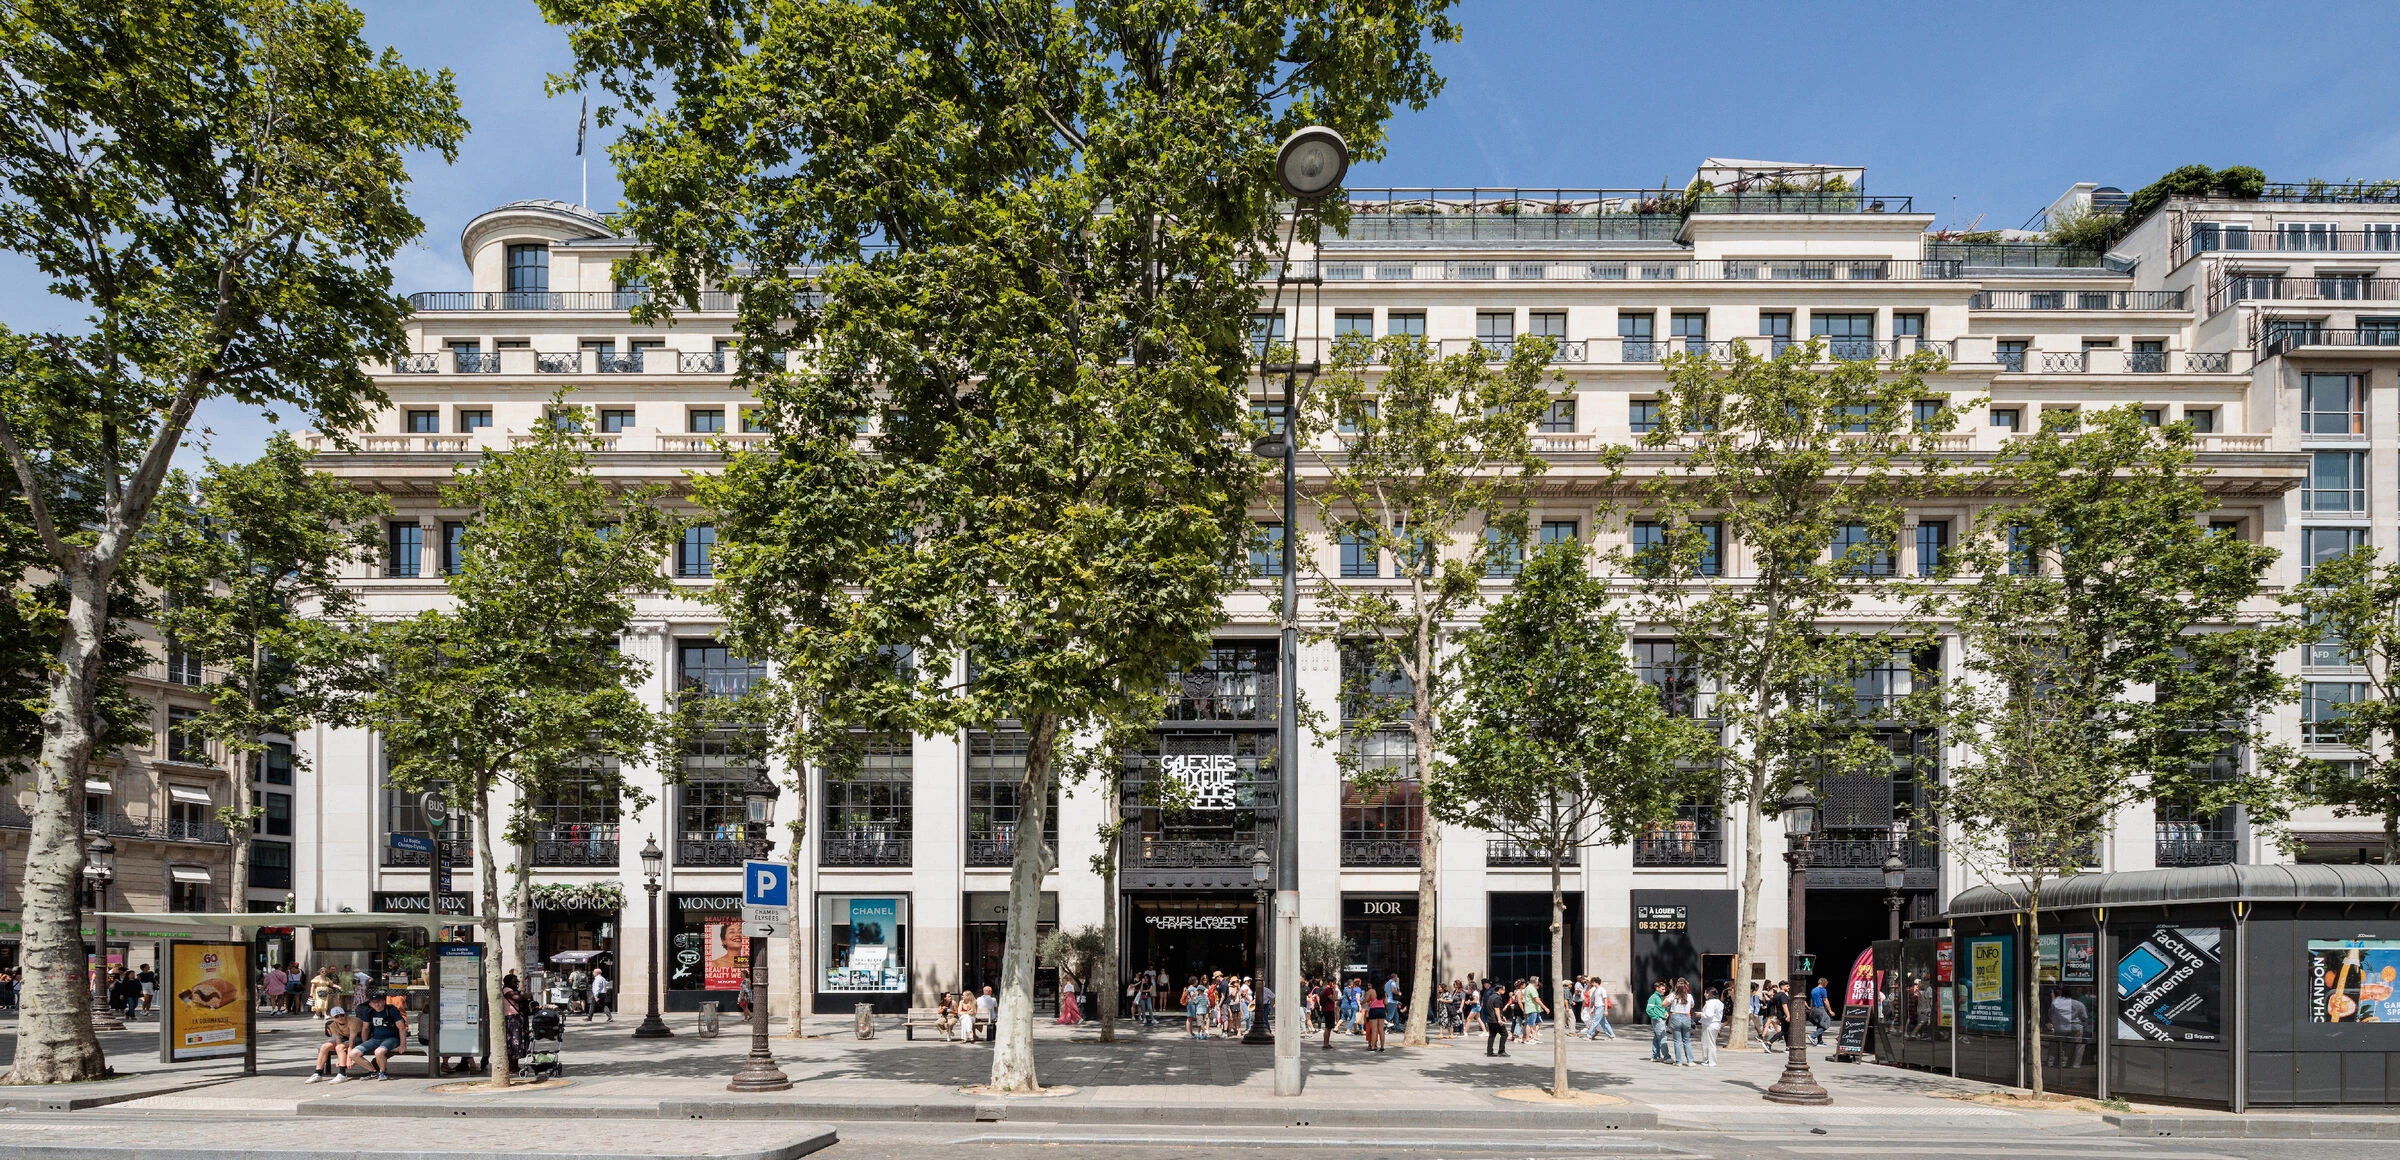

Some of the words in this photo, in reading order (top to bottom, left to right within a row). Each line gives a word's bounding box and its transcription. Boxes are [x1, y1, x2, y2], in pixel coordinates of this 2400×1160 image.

[1161, 755, 1236, 770] GALERIES
[428, 800, 444, 812] BUS
[442, 843, 449, 851] 73
[757, 870, 777, 898] P
[385, 896, 465, 909] MONORIX
[678, 897, 743, 910] MONOPR
[1363, 902, 1402, 914] DIOR
[852, 907, 893, 915] CHANEL
[1145, 916, 1193, 924] GALERIES
[1194, 916, 1248, 924] LAFAYETTE
[1157, 921, 1193, 930] CHAMPS
[1639, 921, 1649, 930] 06
[1649, 921, 1659, 930] 32
[1659, 921, 1667, 930] 15
[1667, 921, 1677, 930] 22
[1677, 921, 1686, 930] 37
[2152, 929, 2204, 968] facture
[2124, 966, 2194, 1021] paiements
[2313, 957, 2325, 1023] CHANDON
